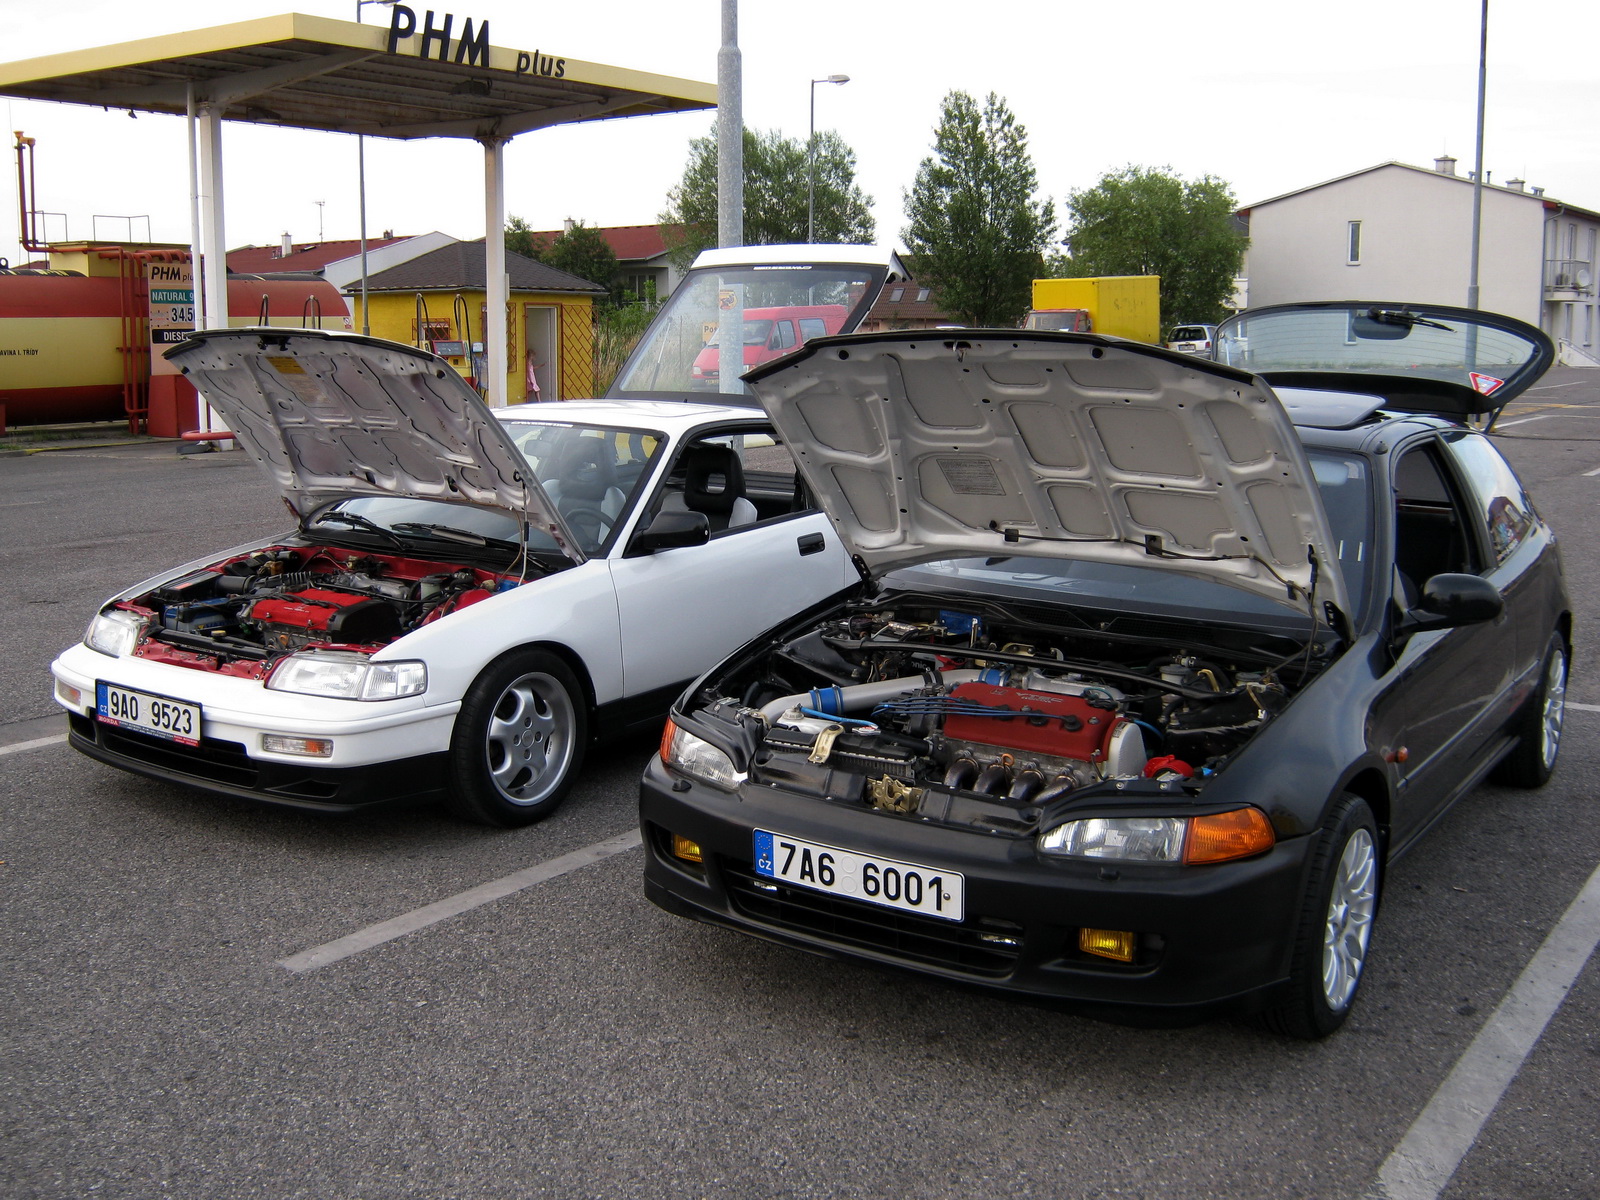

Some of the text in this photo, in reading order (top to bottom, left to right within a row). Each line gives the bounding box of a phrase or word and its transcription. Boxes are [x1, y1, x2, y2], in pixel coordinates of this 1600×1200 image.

[387, 4, 566, 78] PHM plus
[151, 266, 194, 282] PHM plu
[152, 291, 188, 301] NATURAL
[171, 307, 195, 322] 34.5
[99, 704, 108, 713] CZ
[151, 701, 192, 734] 9523
[758, 858, 772, 871] CZ
[780, 842, 943, 911] 7A6 6001
